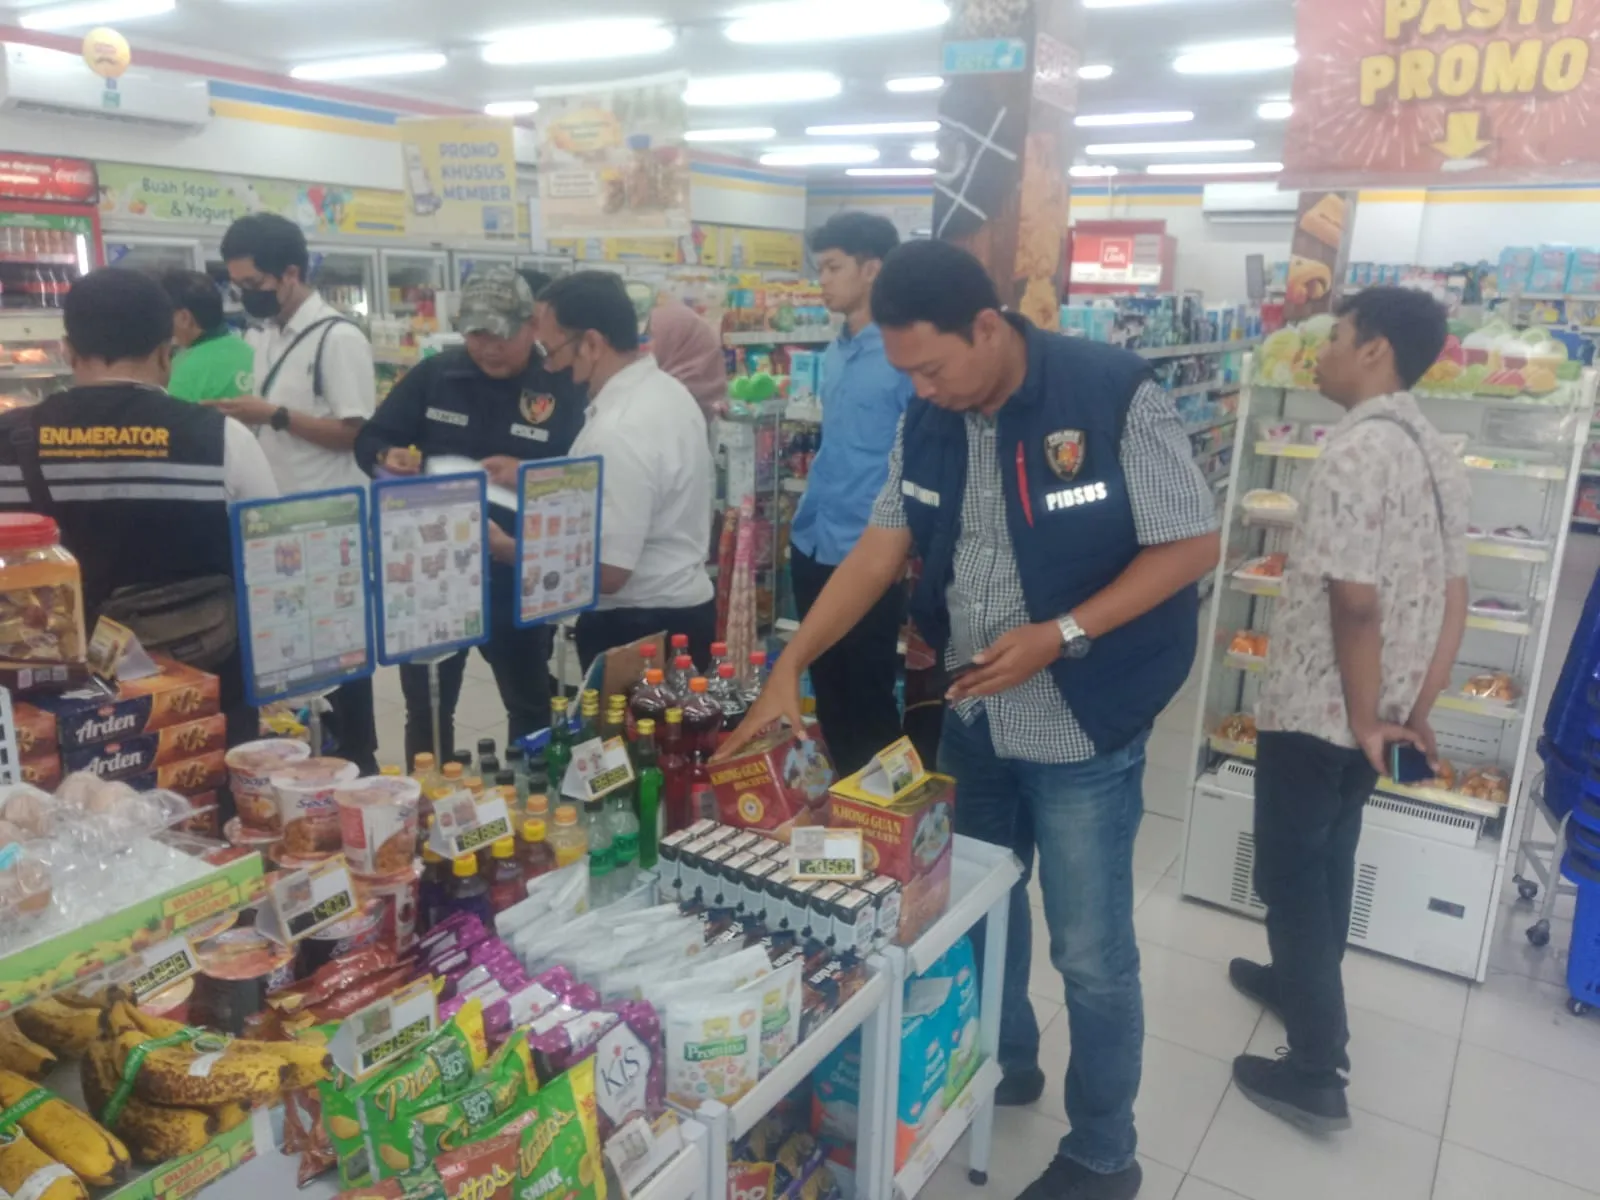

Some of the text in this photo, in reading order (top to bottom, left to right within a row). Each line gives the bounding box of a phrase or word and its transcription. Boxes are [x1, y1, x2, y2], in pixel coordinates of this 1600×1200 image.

[1361, 38, 1589, 106] PROMO
[439, 141, 499, 158] PROMO
[442, 163, 505, 180] KHUSUS
[142, 177, 220, 202] Buah Segar
[444, 184, 511, 201] MEMBER
[171, 201, 235, 224] & Yogurt
[39, 427, 169, 446] ENUMERATOR
[1046, 481, 1107, 511] PIDSUS
[75, 714, 136, 743] Arden
[89, 751, 143, 775] Arden
[832, 803, 902, 834] KHONG GUAN
